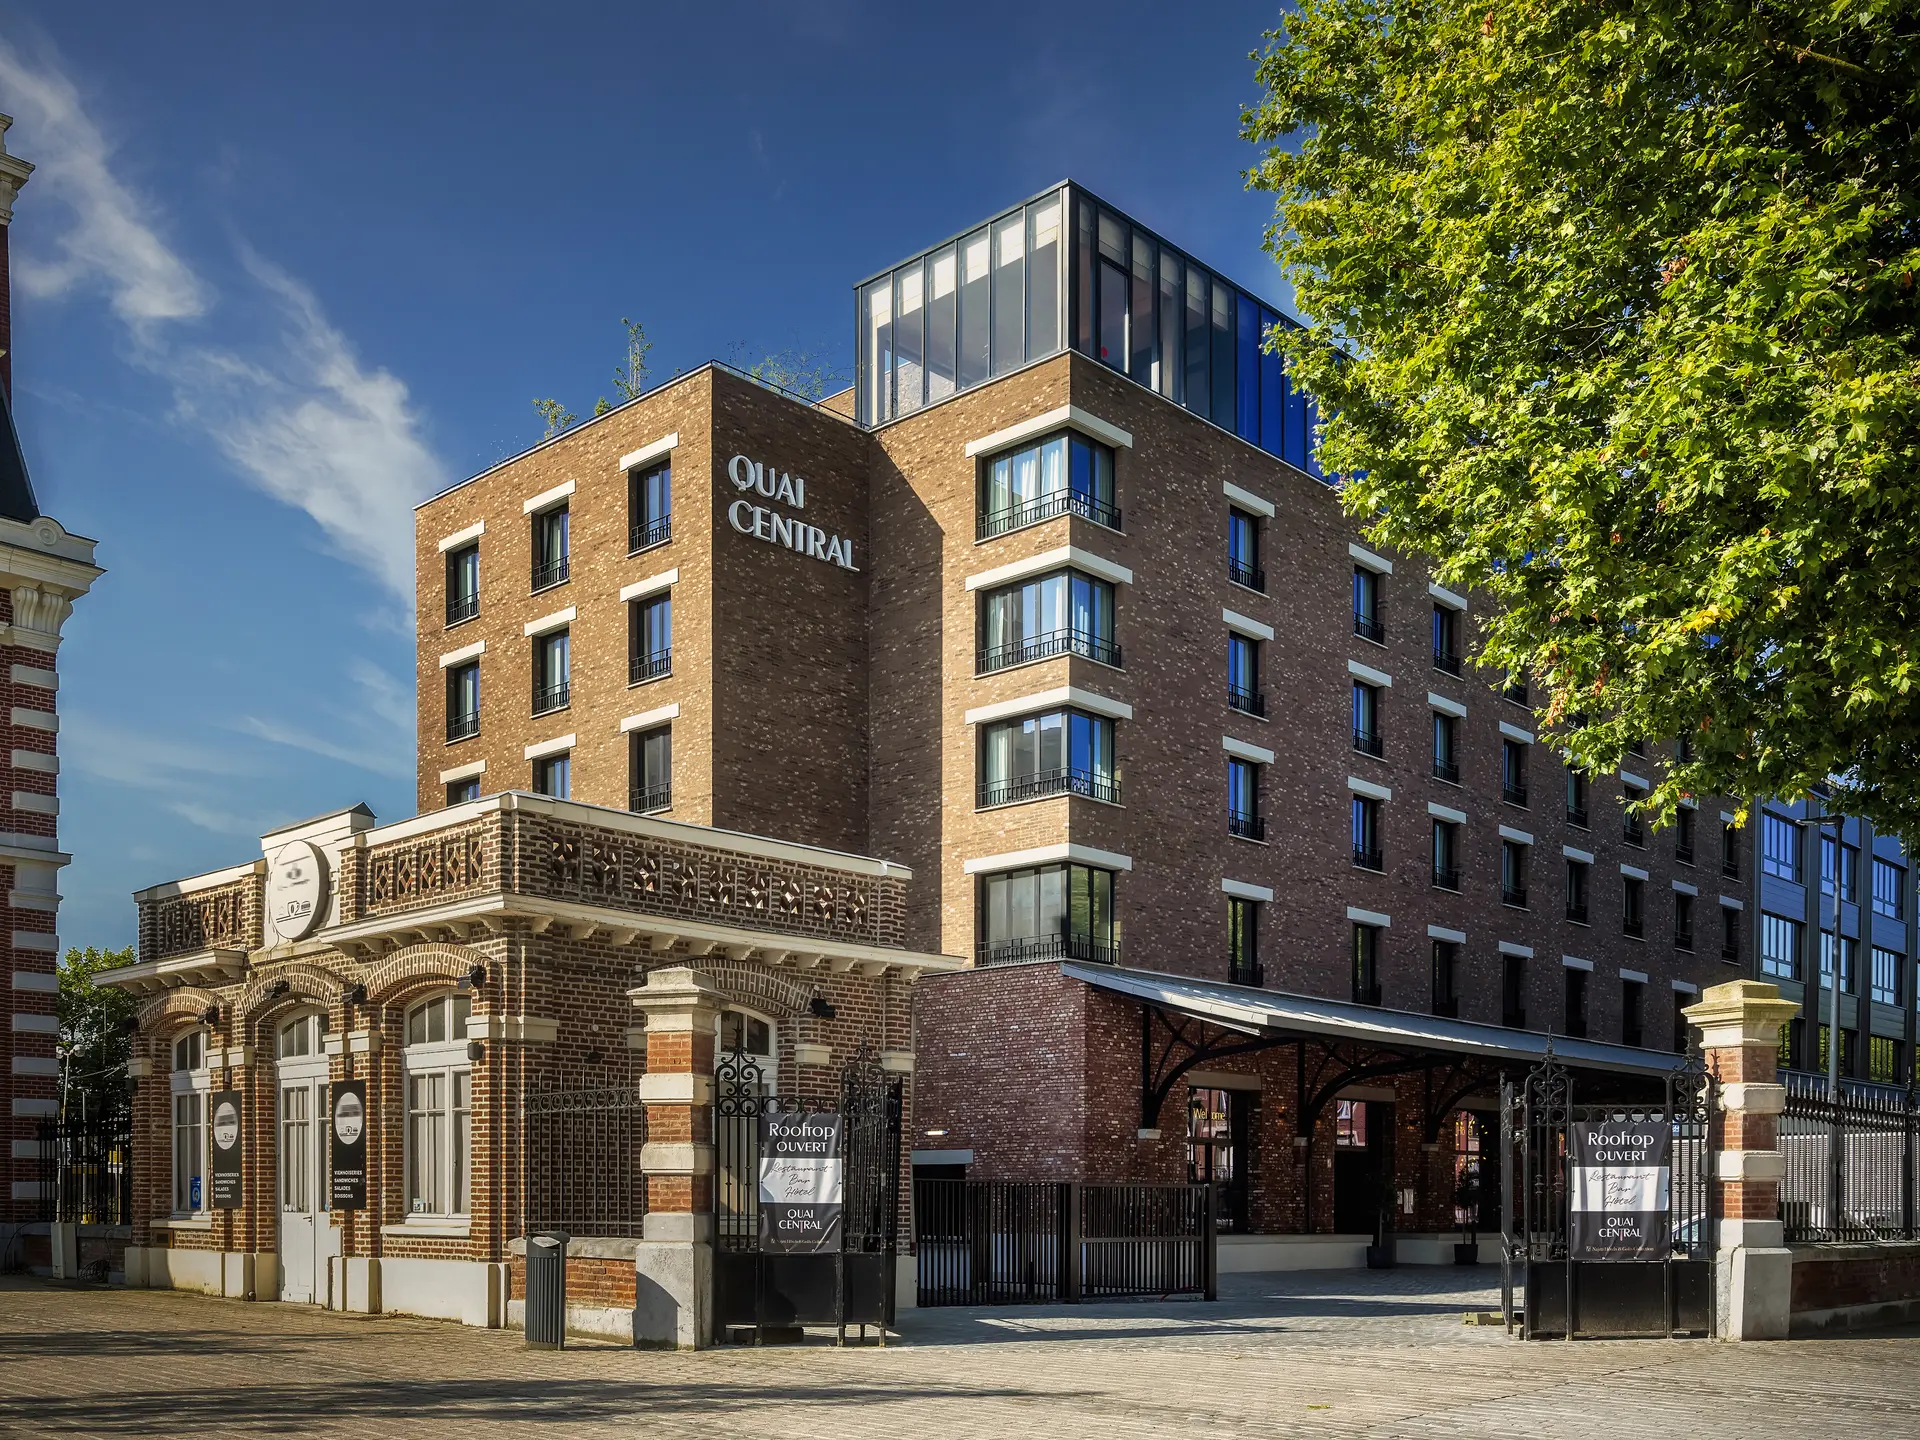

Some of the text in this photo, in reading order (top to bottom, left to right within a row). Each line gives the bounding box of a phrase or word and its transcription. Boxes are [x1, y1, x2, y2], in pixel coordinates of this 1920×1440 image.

[728, 455, 804, 509] QUAI
[728, 500, 860, 572] CENTRAL
[1192, 1107, 1225, 1121] Welome
[769, 1122, 835, 1141] Rooftop
[1588, 1131, 1655, 1148] Rooftop
[776, 1141, 828, 1153] OUVERT
[1595, 1150, 1648, 1162] OUVERT
[770, 1161, 833, 1174] Restaurant
[788, 1173, 811, 1187] Bar
[1588, 1169, 1656, 1182] Restaurant
[1607, 1181, 1632, 1195] Bar
[787, 1209, 814, 1219] QUAI
[778, 1219, 822, 1233] CENTRAL
[1607, 1217, 1634, 1228] QUAI
[1598, 1228, 1643, 1241] CENTRAL
